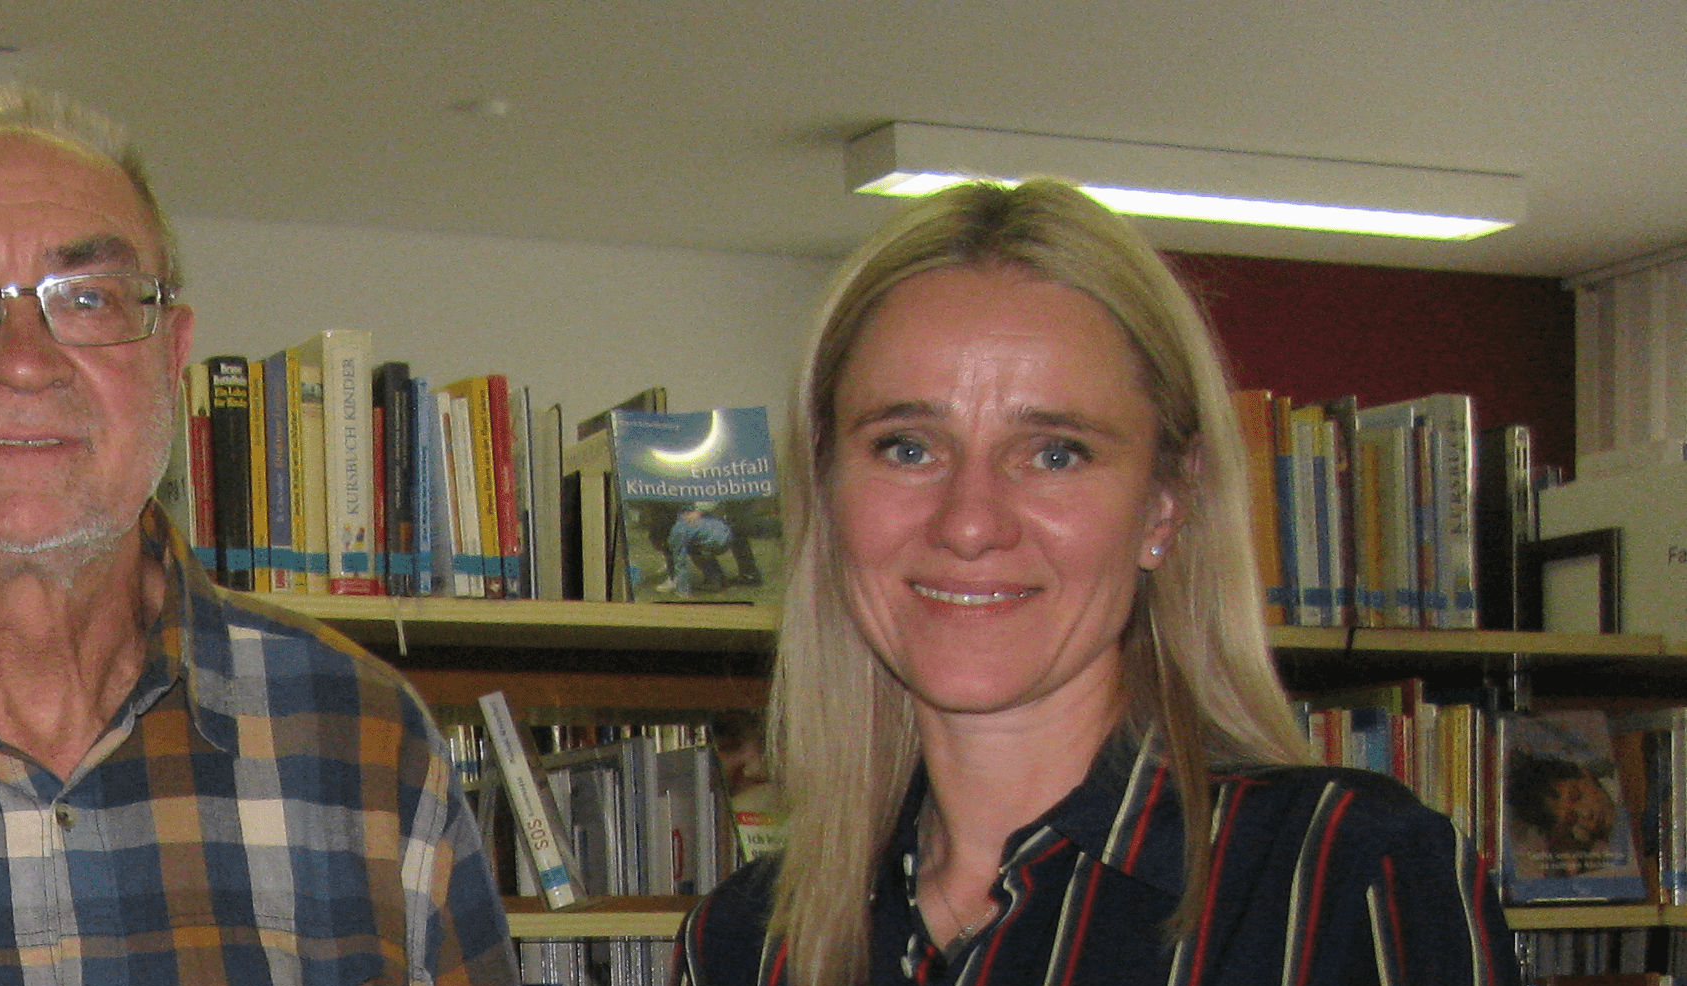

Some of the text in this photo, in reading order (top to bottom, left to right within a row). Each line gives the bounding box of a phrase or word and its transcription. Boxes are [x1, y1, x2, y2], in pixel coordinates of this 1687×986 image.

[342, 357, 360, 517] KURSBUCH KINDER
[691, 458, 769, 478] Ernstfall
[625, 477, 772, 496] Kindermobbing
[526, 817, 551, 852] SOS
